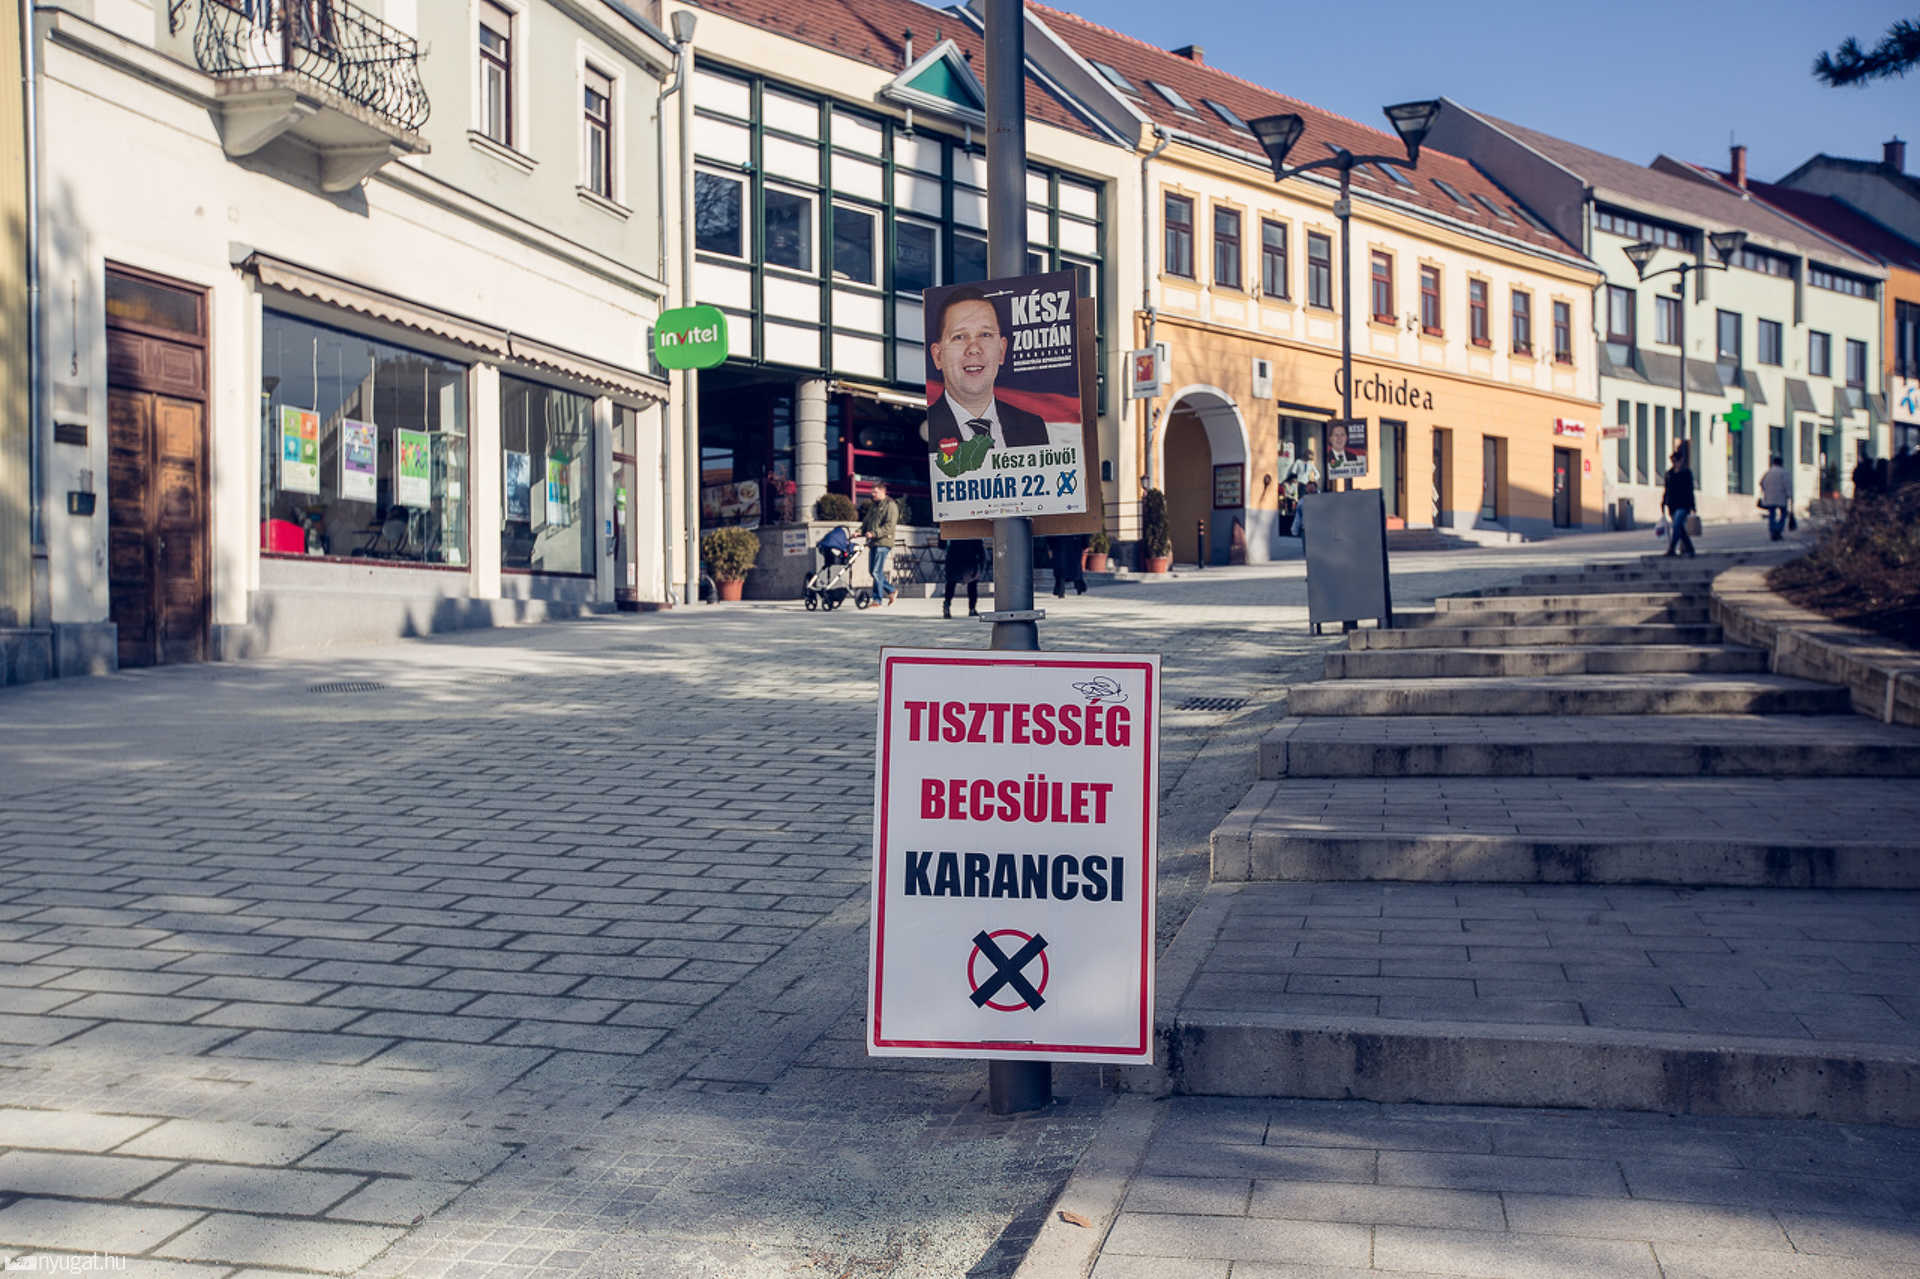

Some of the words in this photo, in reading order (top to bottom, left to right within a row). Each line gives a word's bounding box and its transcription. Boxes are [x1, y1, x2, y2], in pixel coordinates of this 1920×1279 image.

[1011, 289, 1070, 326] KÉSZ
[661, 324, 718, 346] invitel
[1013, 323, 1071, 351] ZOLTÁN
[992, 452, 1025, 469] Kész
[1027, 453, 1037, 467] a
[1040, 447, 1076, 468] jövő!
[936, 474, 1017, 502] FEBRUÁR
[1021, 474, 1050, 497] 22.
[904, 698, 1131, 747] TISZTESSÉG
[920, 774, 1113, 824] BECSÜLET
[904, 851, 1124, 901] KARANCSI
